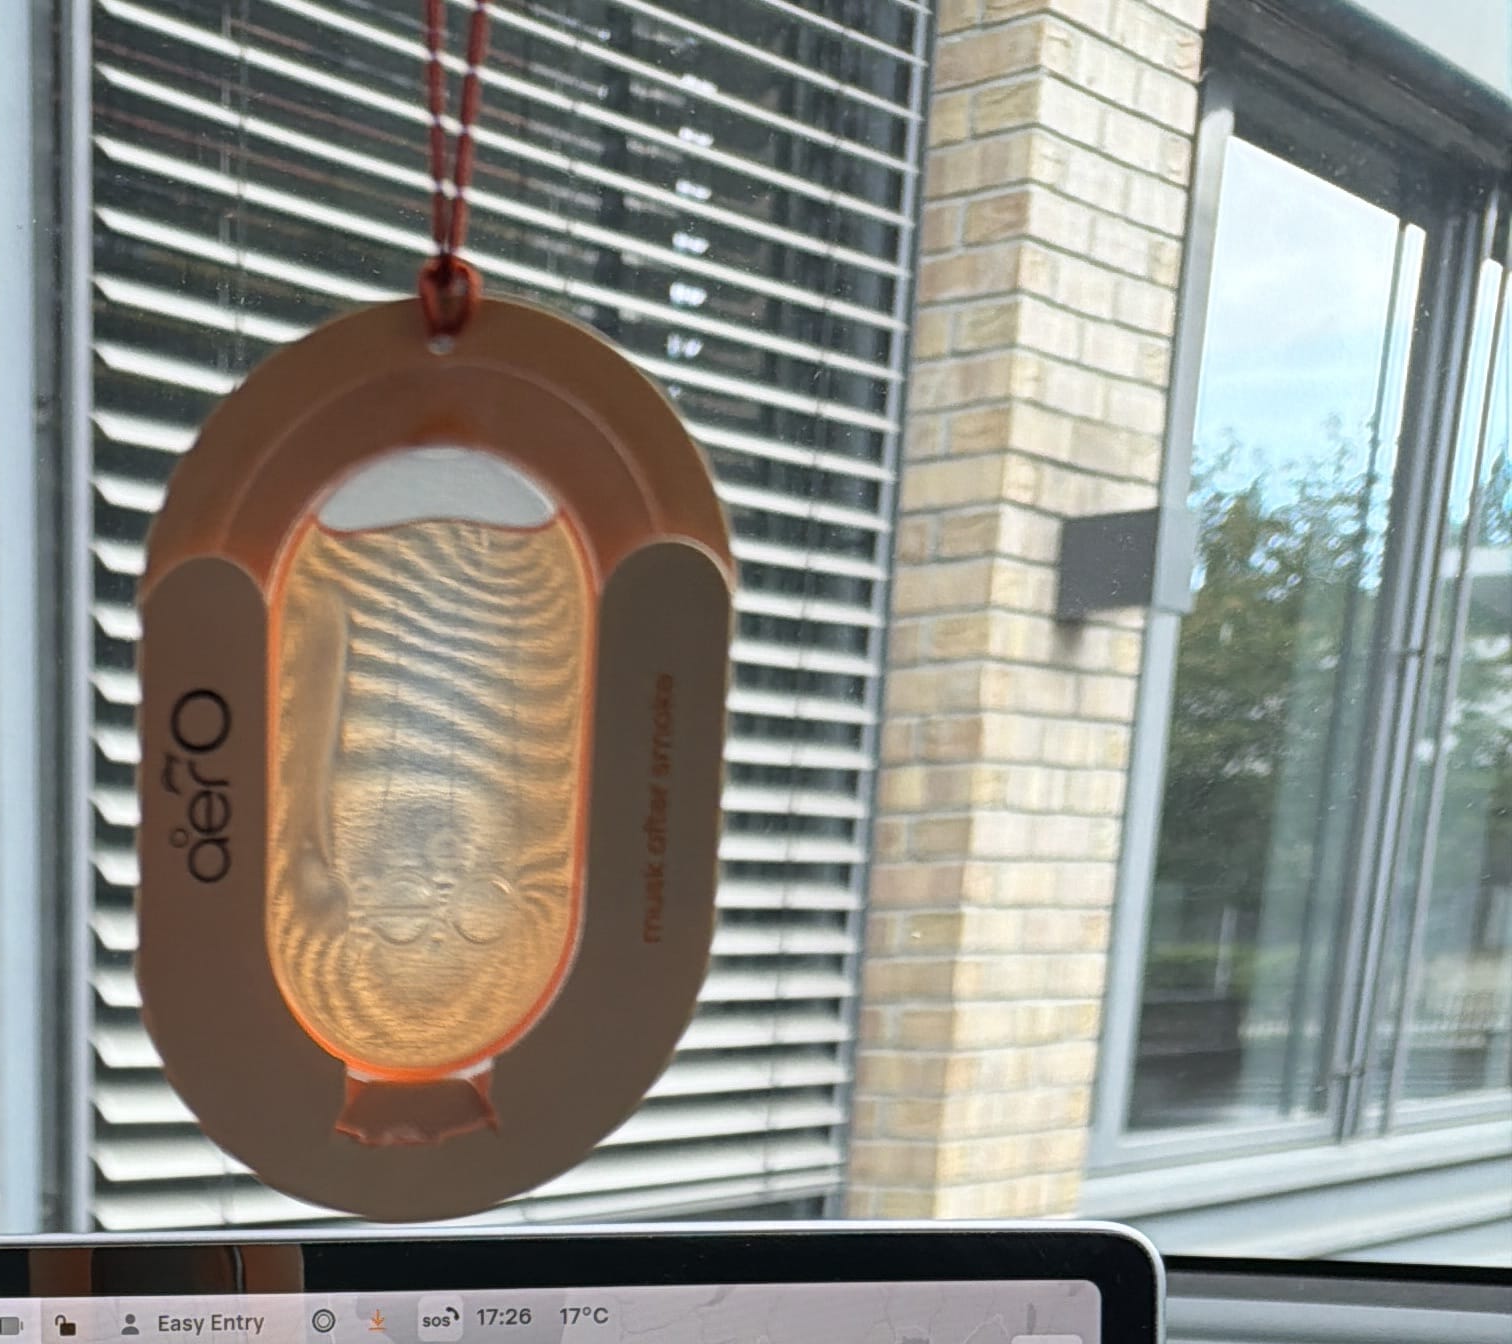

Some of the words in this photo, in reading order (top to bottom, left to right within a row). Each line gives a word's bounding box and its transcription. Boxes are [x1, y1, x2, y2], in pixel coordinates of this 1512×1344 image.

[158, 1316, 204, 1336] Easy
[211, 1314, 265, 1335] Entry
[476, 1308, 532, 1326] 17:26
[559, 1306, 609, 1325] 17°C
